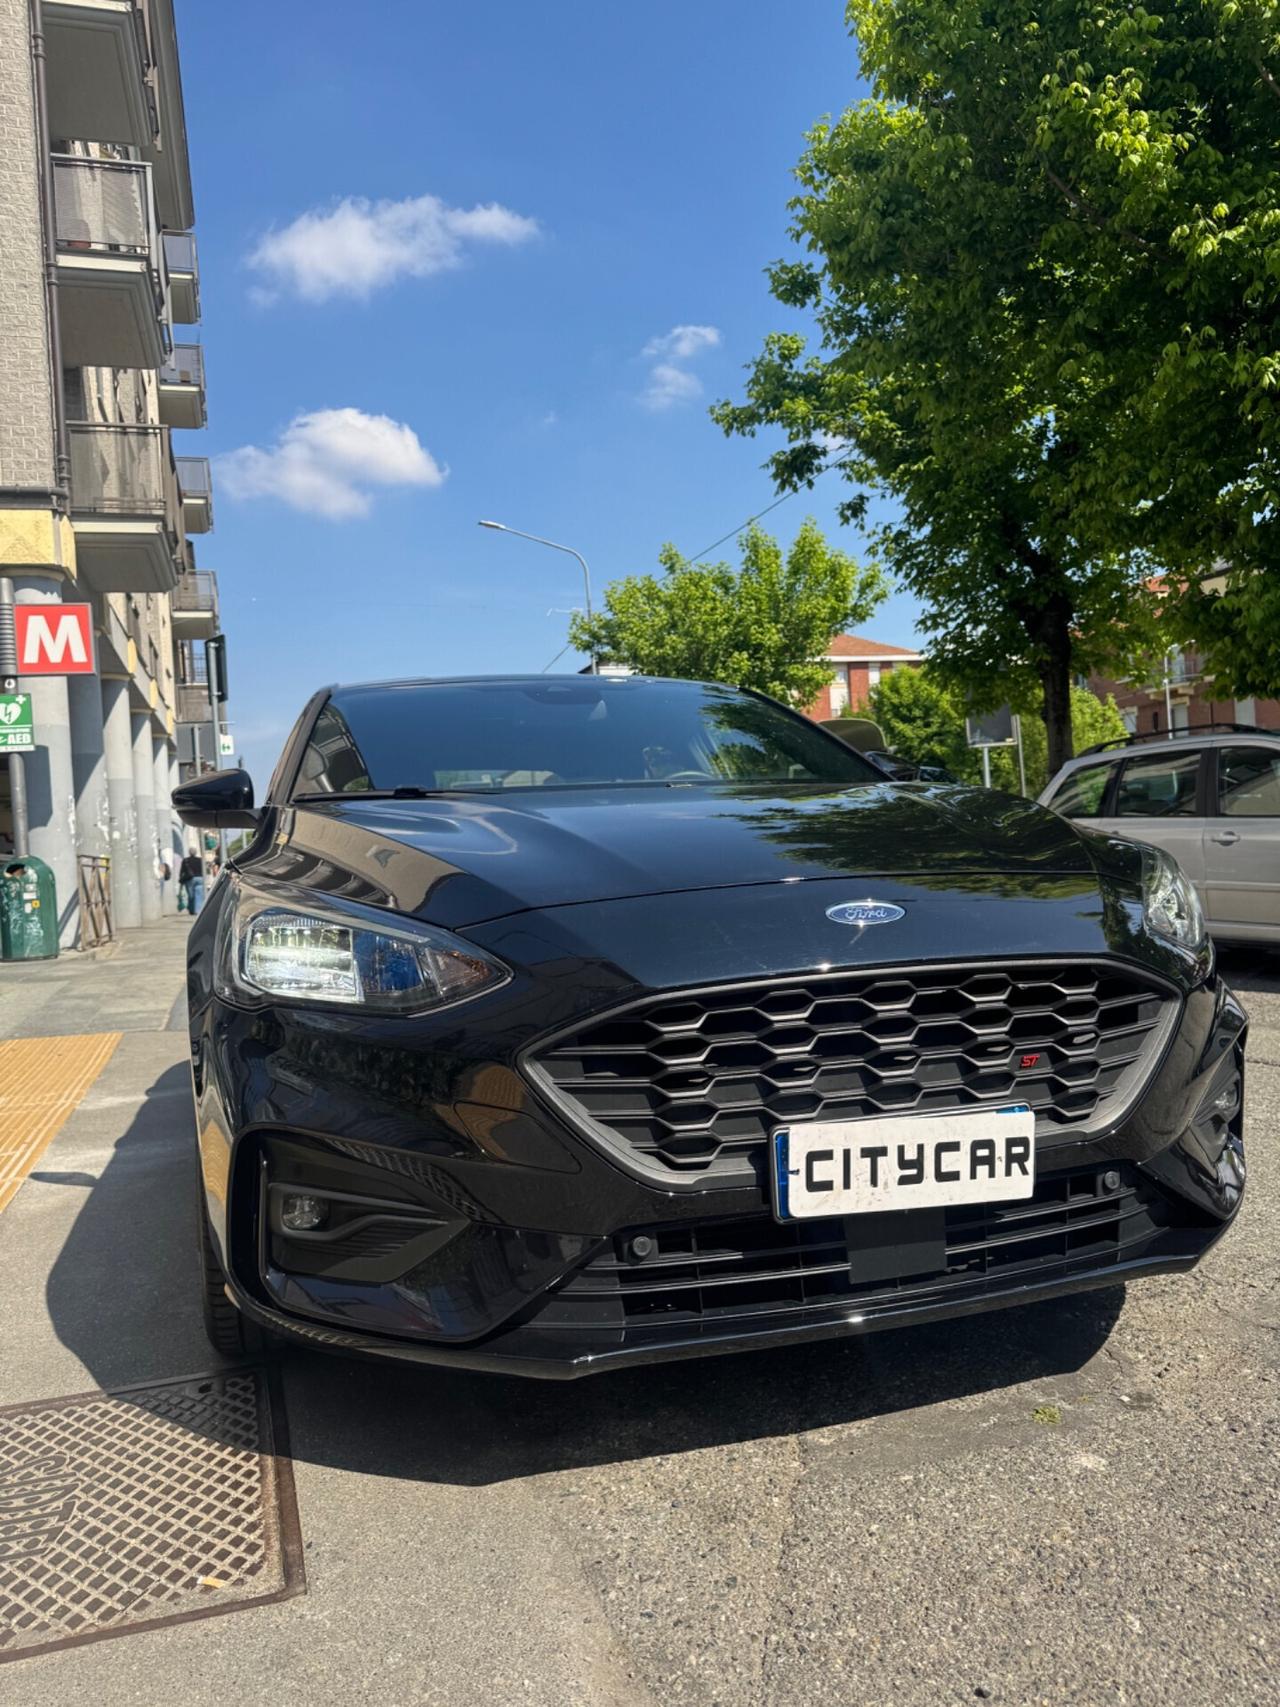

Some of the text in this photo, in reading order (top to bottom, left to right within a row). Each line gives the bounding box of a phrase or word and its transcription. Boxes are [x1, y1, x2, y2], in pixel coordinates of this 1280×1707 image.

[23, 615, 88, 663] M
[7, 733, 32, 744] AED
[844, 905, 887, 920] Ford
[1020, 1054, 1040, 1068] ST
[805, 1136, 1030, 1193] CITYCAR
